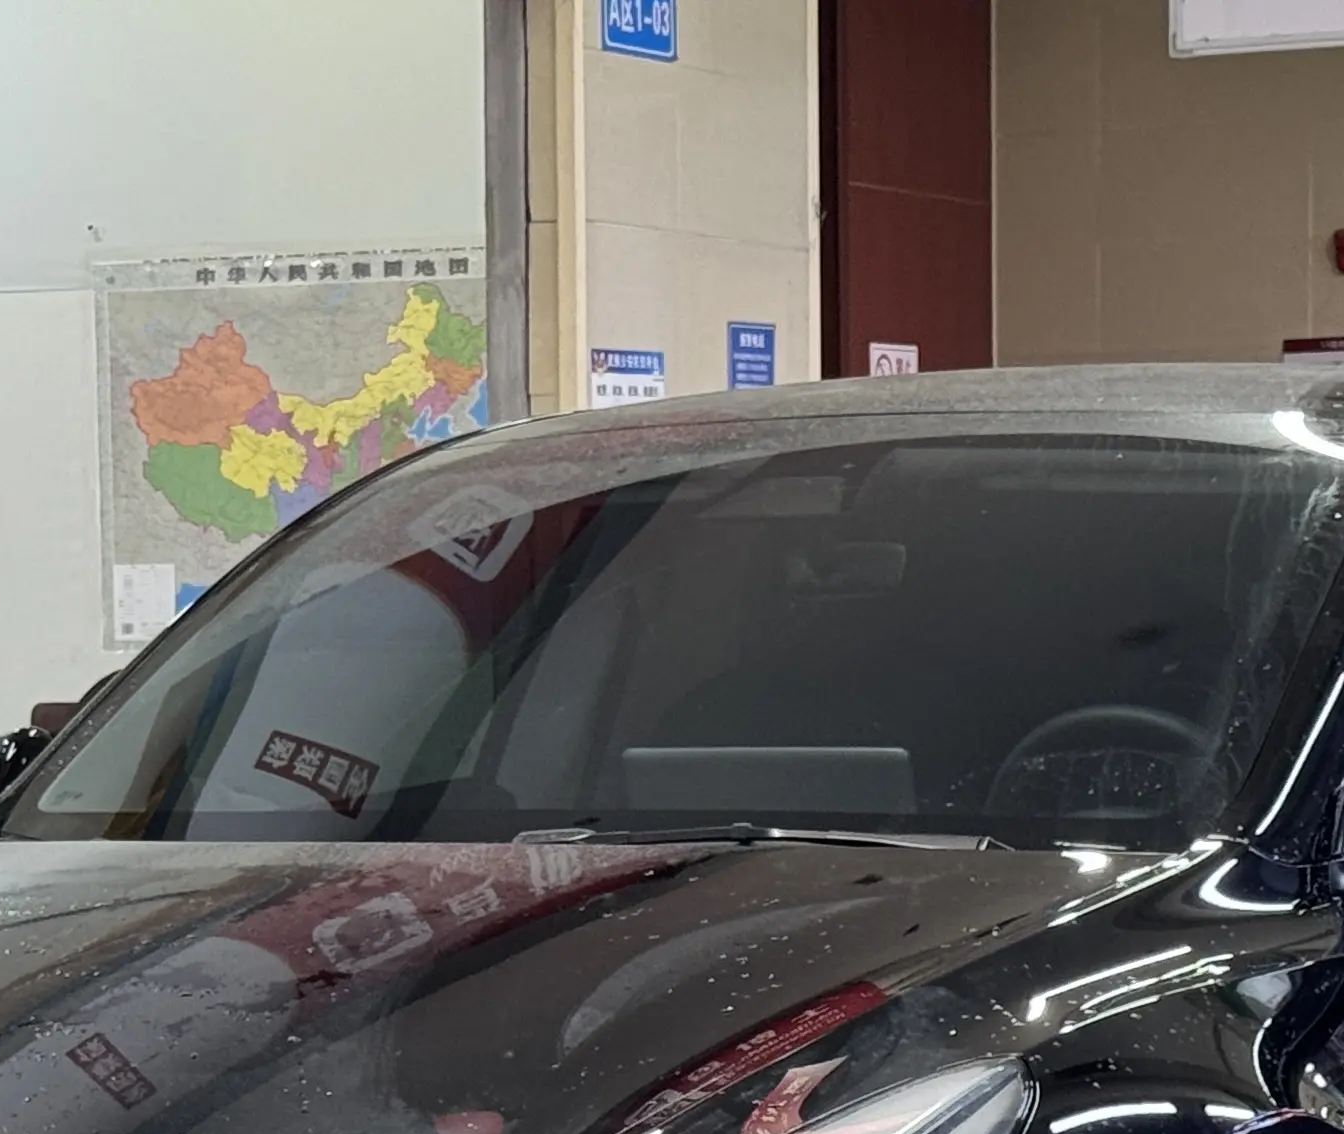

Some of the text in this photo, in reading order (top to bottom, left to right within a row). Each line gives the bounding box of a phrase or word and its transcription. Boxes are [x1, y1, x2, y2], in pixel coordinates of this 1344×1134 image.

[608, 0, 671, 36] A区1-03
[195, 256, 470, 287] 中华人民共和国地图
